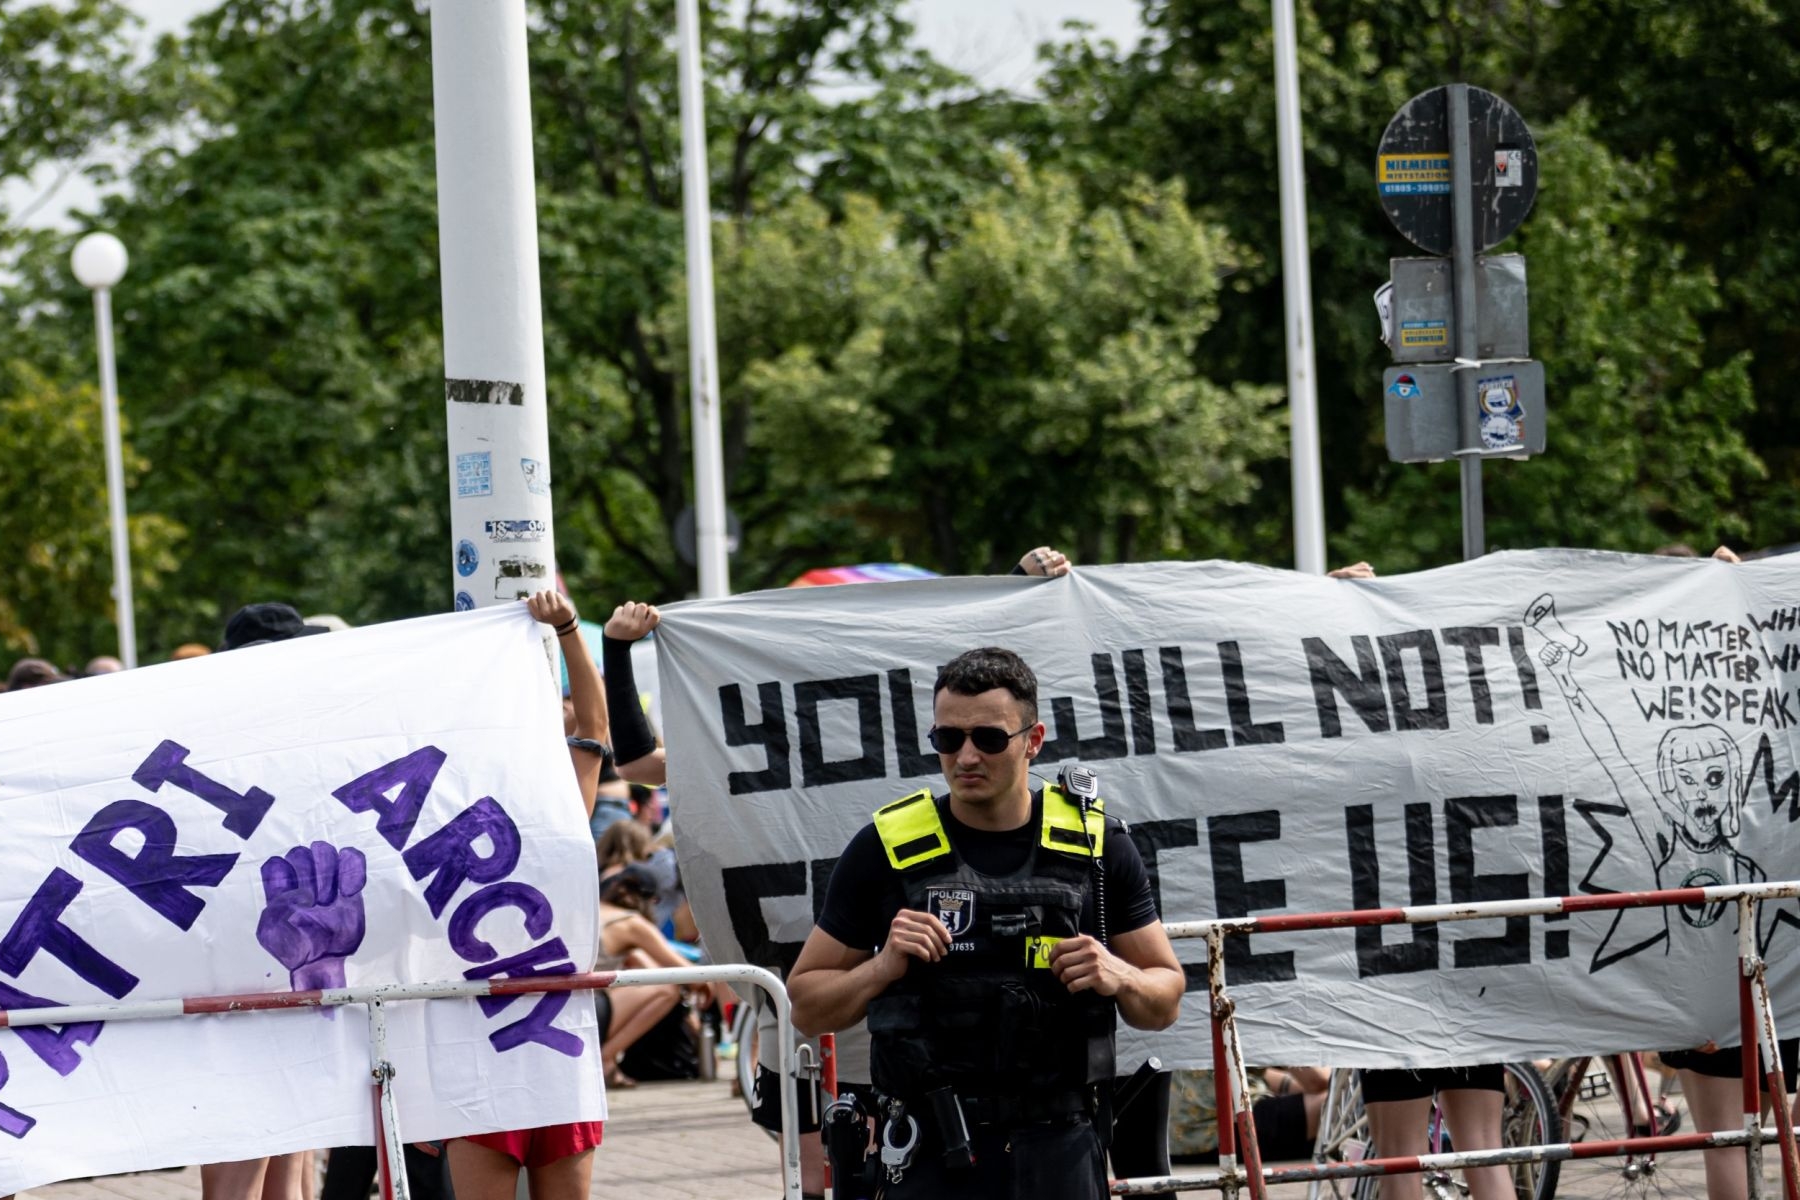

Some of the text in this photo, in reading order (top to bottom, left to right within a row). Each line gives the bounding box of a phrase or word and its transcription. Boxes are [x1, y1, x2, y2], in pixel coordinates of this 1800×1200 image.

[1606, 607, 1800, 652] NO MATTER WH
[1616, 648, 1655, 681] NO
[1664, 651, 1762, 684] MATTER
[718, 666, 944, 796] YOU
[1301, 626, 1551, 745] NOT!
[1700, 683, 1798, 730] SPEAK
[331, 745, 585, 1058] ARCHY
[931, 890, 971, 900] POLIZEI
[1344, 795, 1571, 979] US!
